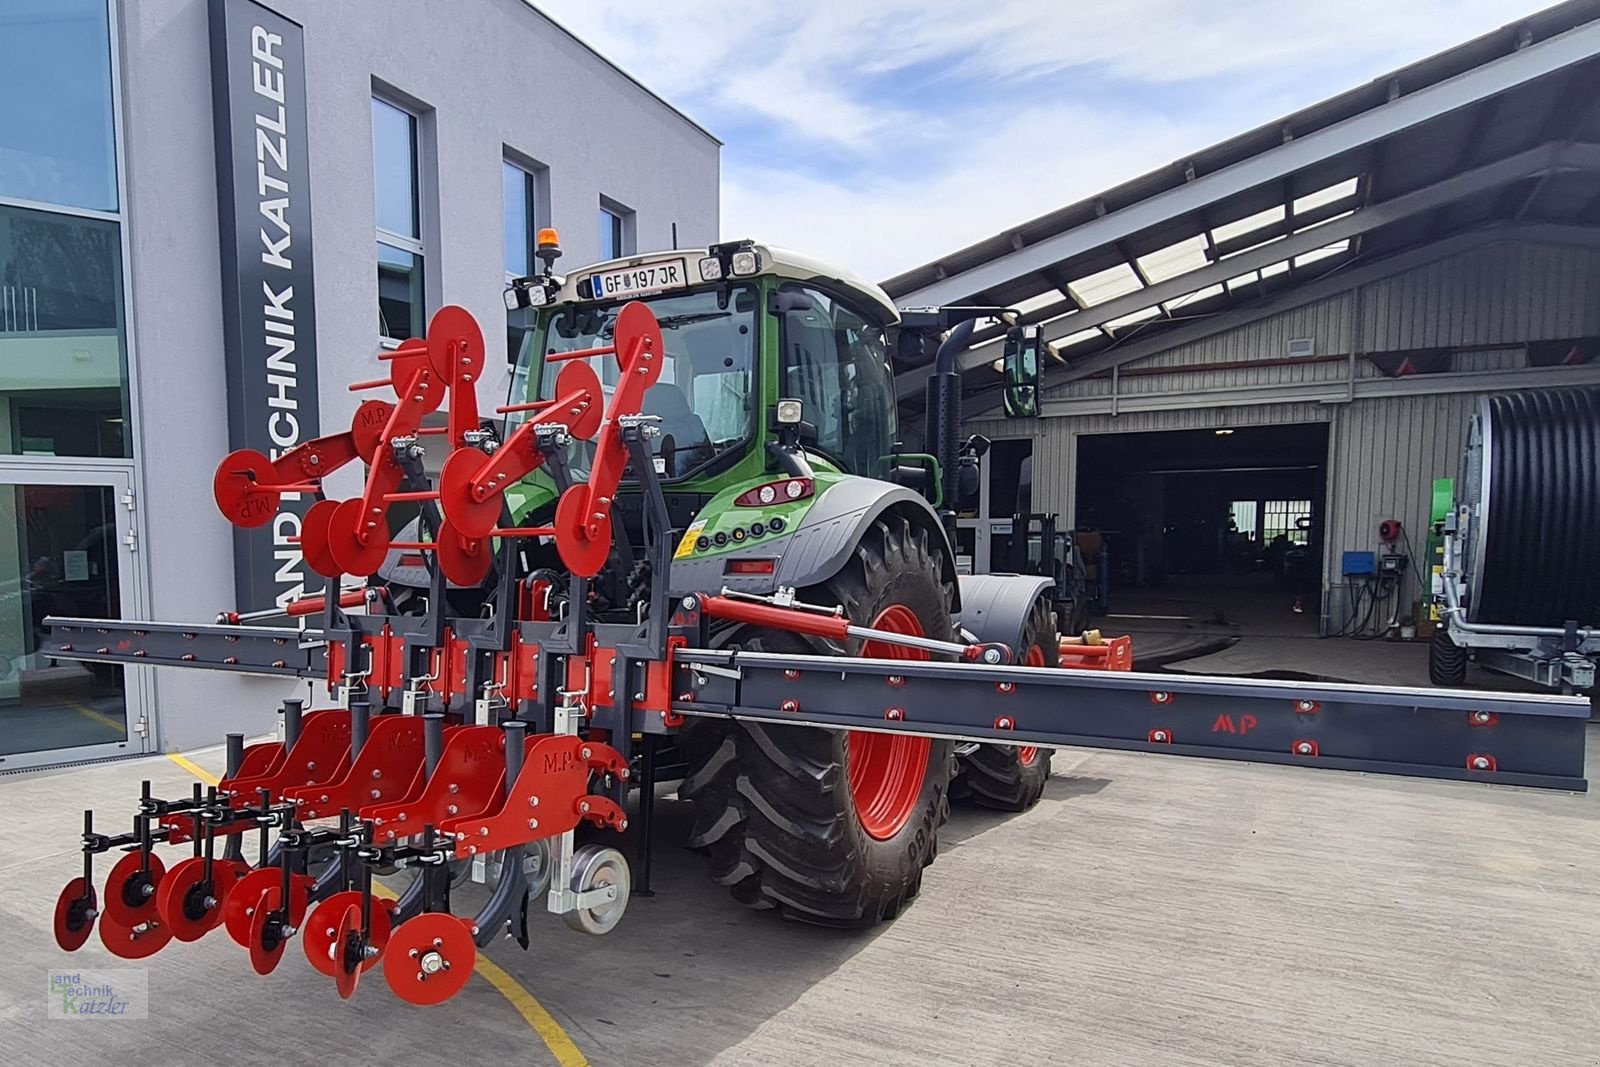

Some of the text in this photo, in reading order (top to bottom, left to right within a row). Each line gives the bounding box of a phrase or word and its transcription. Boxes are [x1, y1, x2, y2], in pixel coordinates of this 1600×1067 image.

[605, 274, 622, 293] GF
[632, 268, 656, 289] 197
[659, 265, 679, 284] JR
[252, 25, 307, 632] ANDCHNIK KATZLER
[1211, 713, 1259, 737] MP
[544, 750, 575, 774] M.P.
